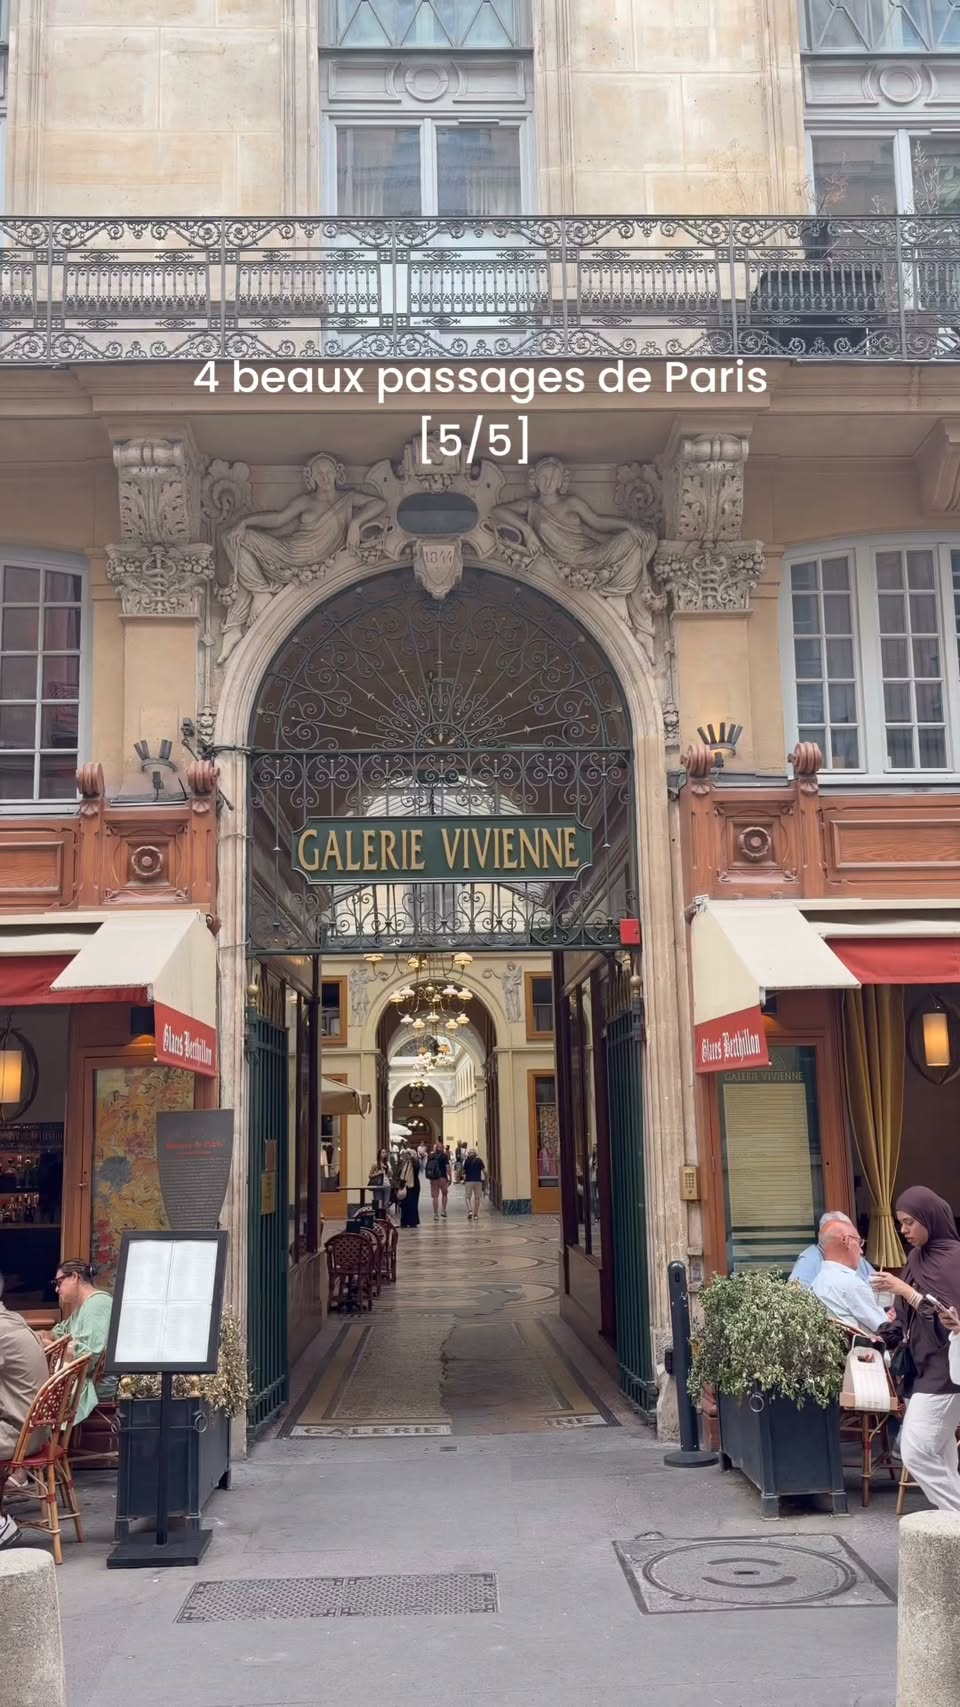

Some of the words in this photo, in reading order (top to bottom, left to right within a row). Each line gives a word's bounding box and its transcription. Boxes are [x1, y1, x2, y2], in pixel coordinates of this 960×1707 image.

[425, 550, 453, 564] 1844
[298, 828, 426, 872] GALERIE
[440, 826, 581, 870] VIVIENNE
[162, 1023, 183, 1057] Glaces
[183, 1030, 212, 1067] Berthillon
[701, 1037, 722, 1063] Glaces
[722, 1028, 761, 1062] Berthillon
[723, 1071, 760, 1081] GALERIE
[761, 1071, 804, 1081] VIVIENNE
[303, 1426, 441, 1436] GALERIE
